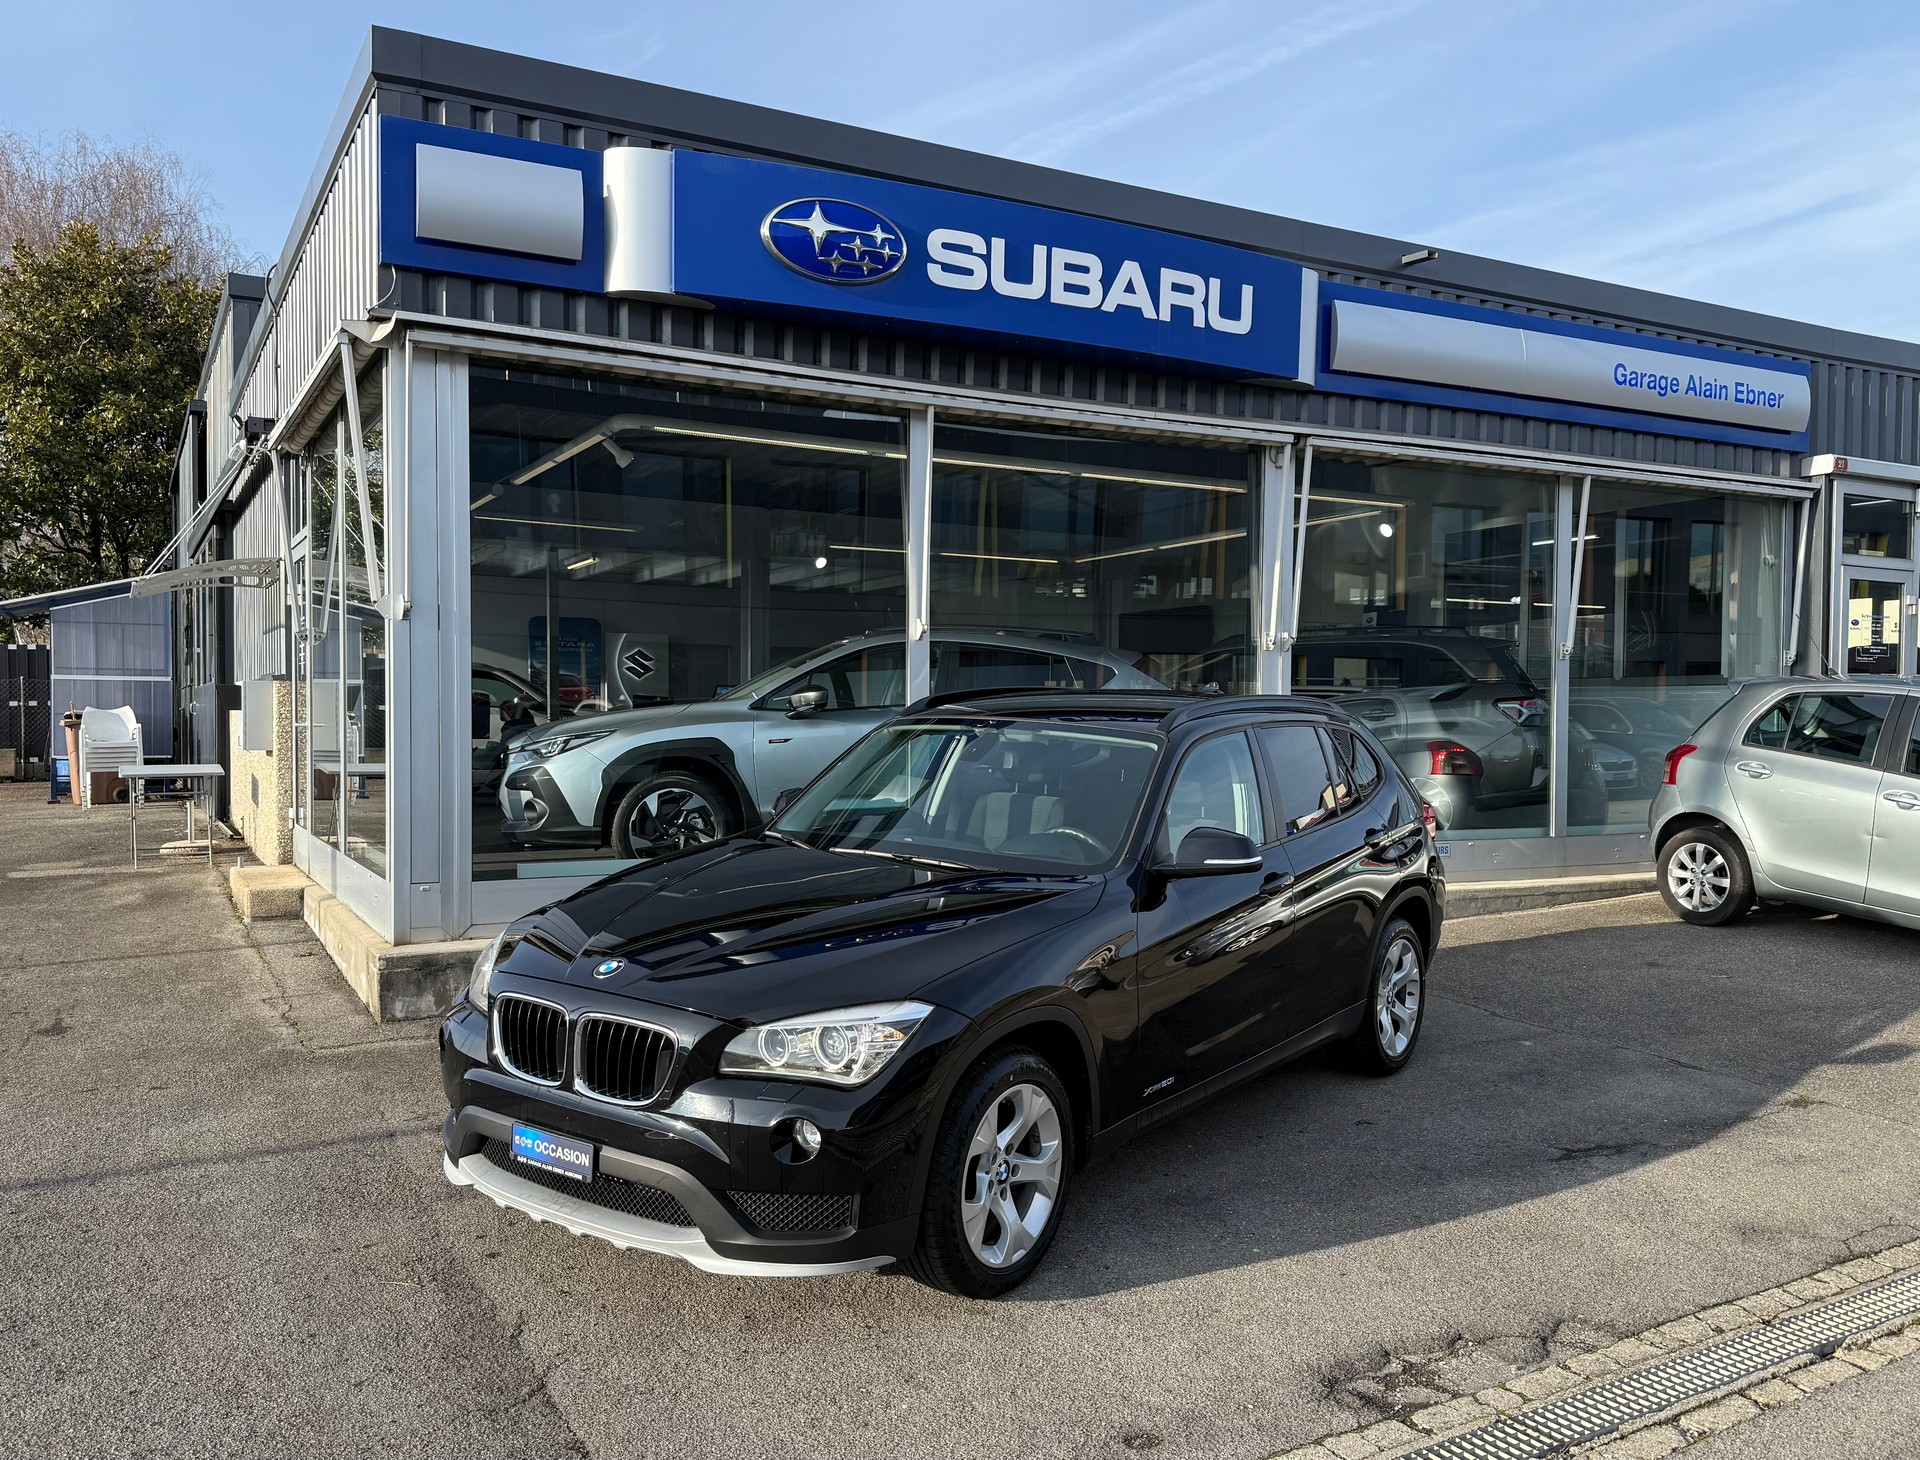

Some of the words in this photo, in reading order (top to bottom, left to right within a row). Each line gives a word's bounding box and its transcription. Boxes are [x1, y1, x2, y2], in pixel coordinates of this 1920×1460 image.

[927, 228, 1253, 335] SUBARU
[1613, 362, 1680, 397] Garage
[1684, 374, 1729, 401] Alain
[1734, 381, 1785, 409] Ebner
[534, 1140, 589, 1166] OCCASION
